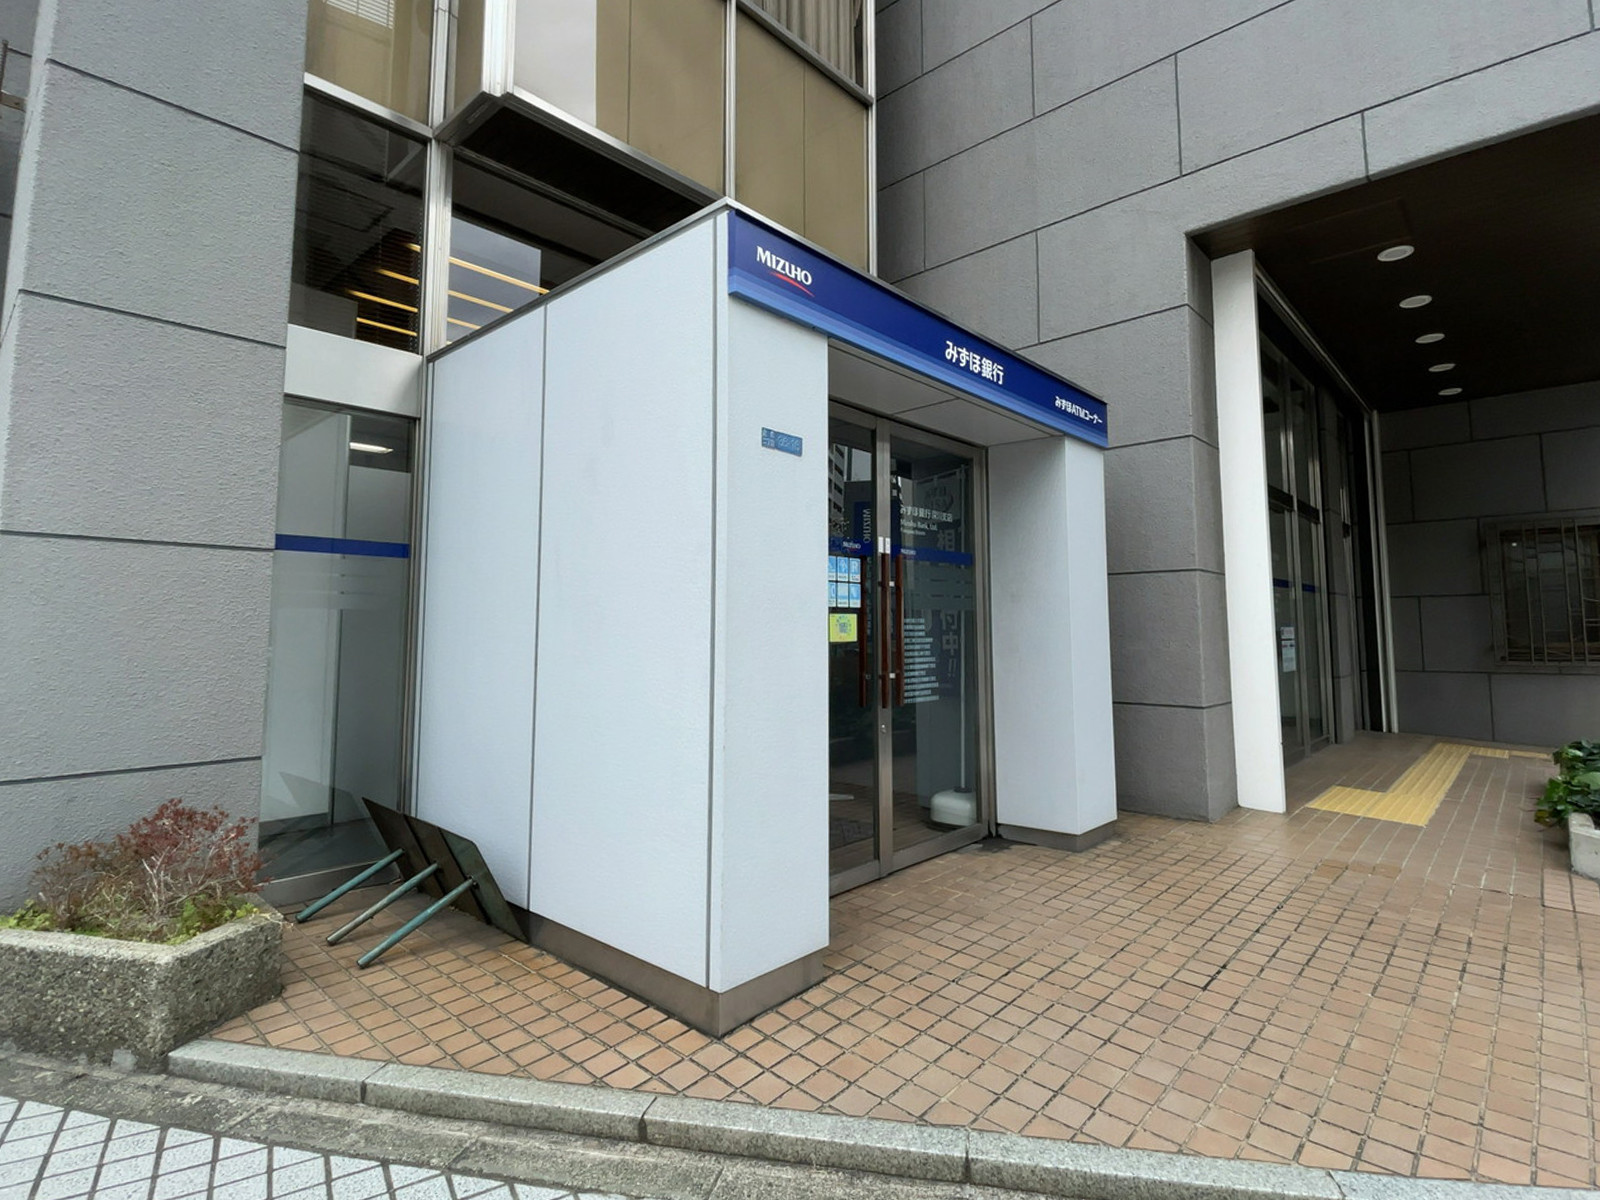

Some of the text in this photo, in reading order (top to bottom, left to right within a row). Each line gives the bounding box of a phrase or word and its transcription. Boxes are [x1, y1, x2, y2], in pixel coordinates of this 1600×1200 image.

[756, 245, 813, 286] MIZUHO
[945, 340, 1004, 385] みずほ銀行
[1055, 395, 1103, 424] みずほATMコーナー
